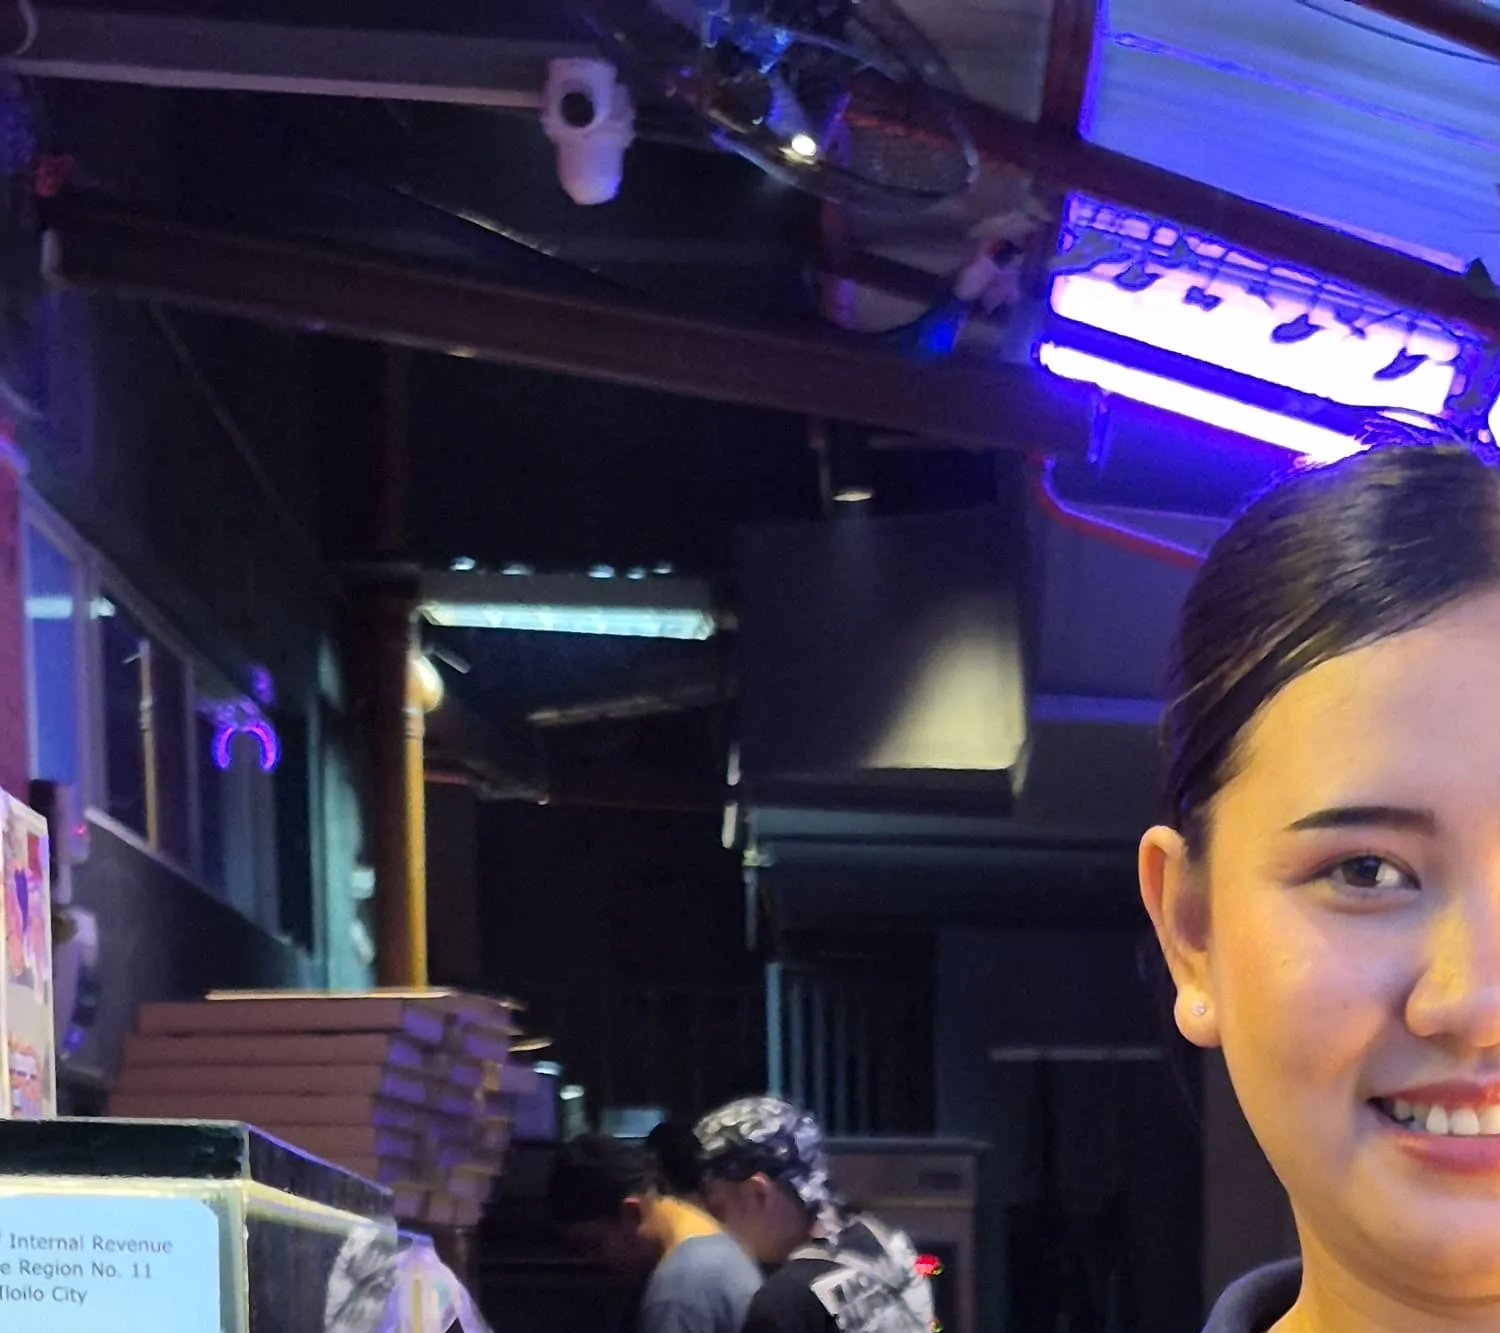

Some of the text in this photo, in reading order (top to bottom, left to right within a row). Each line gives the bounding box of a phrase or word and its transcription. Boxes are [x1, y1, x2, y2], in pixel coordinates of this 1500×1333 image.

[10, 1232, 173, 1253] Internal Revenue
[19, 1259, 83, 1279] Region
[92, 1262, 122, 1278] No.
[133, 1262, 151, 1279] 11
[52, 1286, 87, 1305] City
